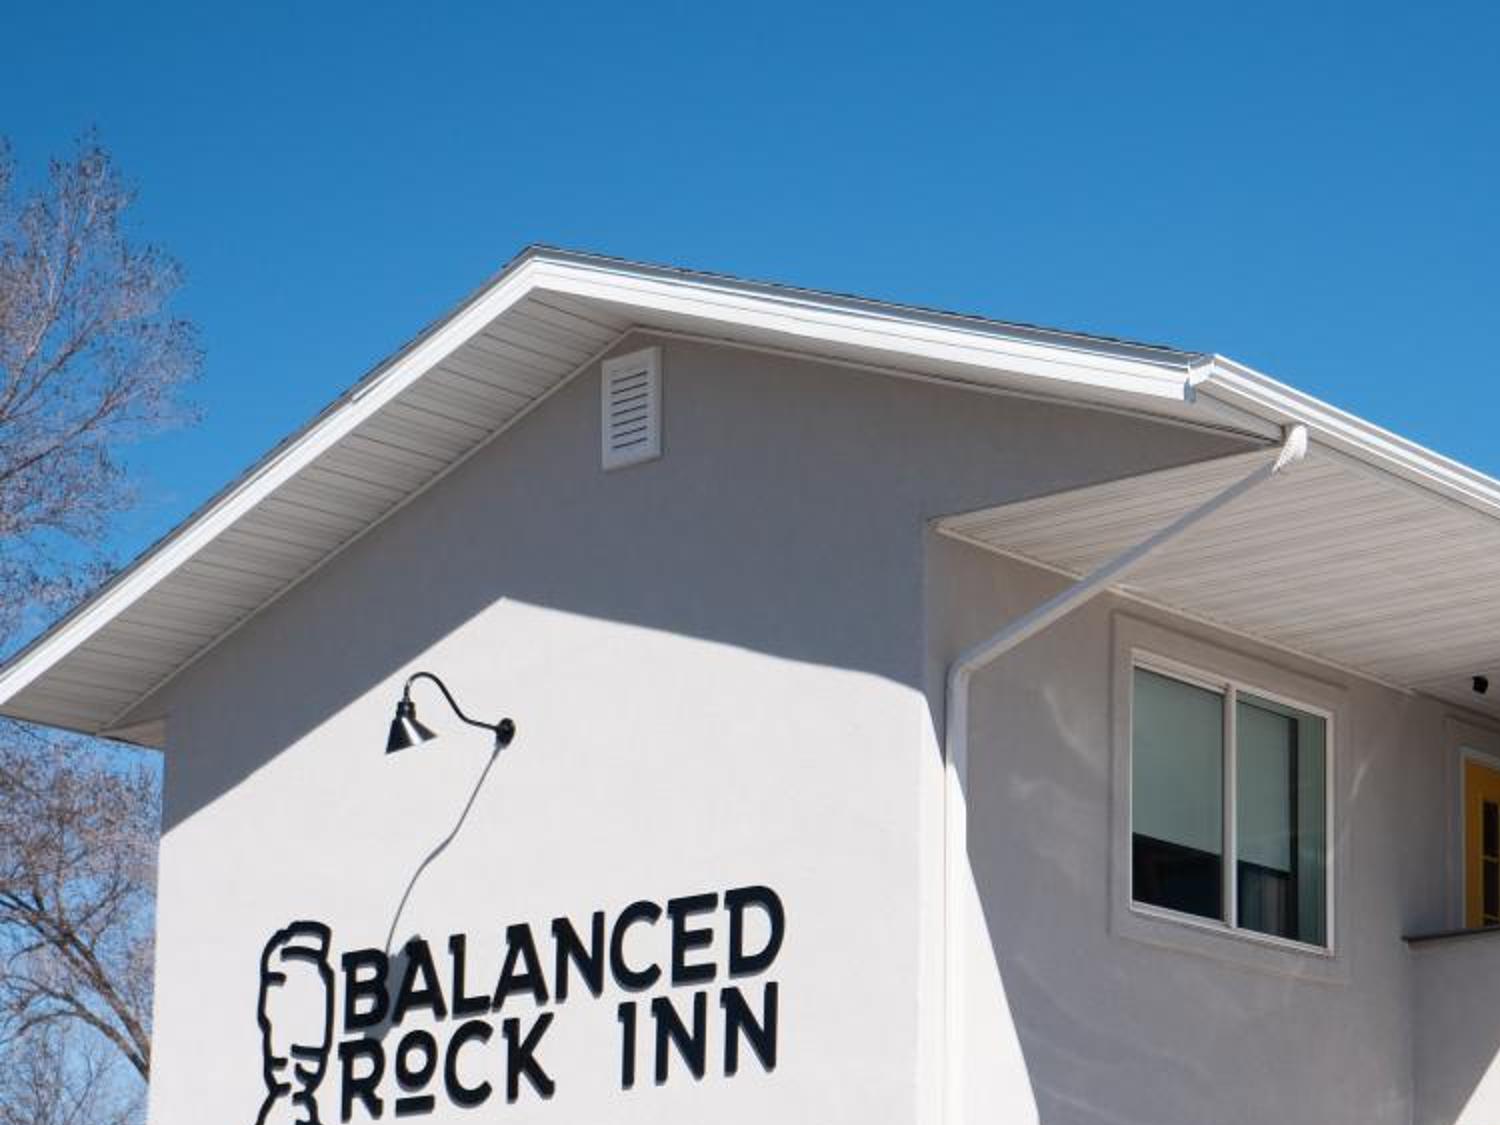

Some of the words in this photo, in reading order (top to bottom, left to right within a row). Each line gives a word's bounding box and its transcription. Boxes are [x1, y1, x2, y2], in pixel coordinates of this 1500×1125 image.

[340, 885, 786, 1035] BALANCED
[339, 1012, 556, 1124] ROCK
[617, 980, 779, 1091] INN
